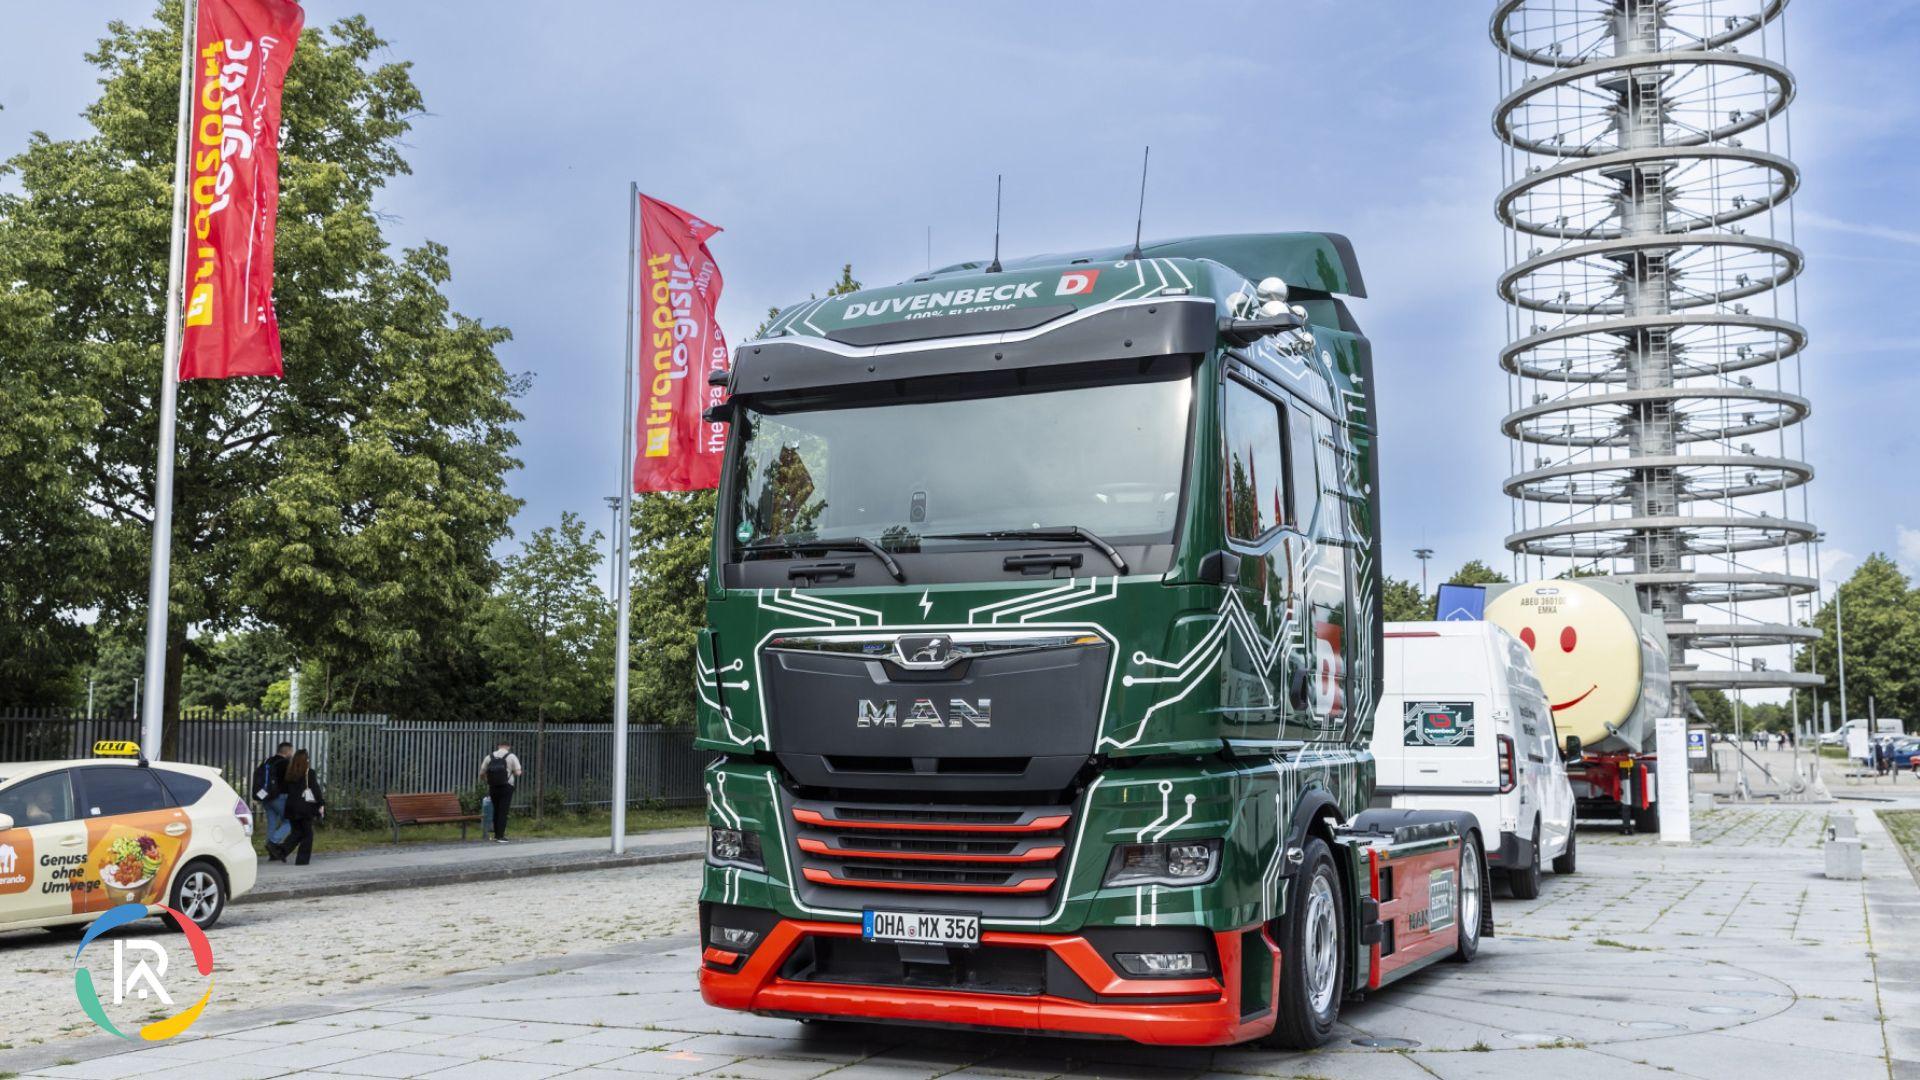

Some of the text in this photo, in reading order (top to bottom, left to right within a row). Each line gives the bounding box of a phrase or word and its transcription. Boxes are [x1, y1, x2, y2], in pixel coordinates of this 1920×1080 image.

[843, 281, 1042, 322] DUVENBECK
[670, 254, 698, 380] logistic
[647, 253, 675, 424] transport
[857, 698, 991, 728] MAN
[40, 854, 88, 866] Genuss
[52, 867, 84, 879] ohne
[42, 880, 101, 893] Umwege
[874, 914, 905, 936] OHA
[918, 917, 939, 938] MX
[945, 919, 977, 940] 356
